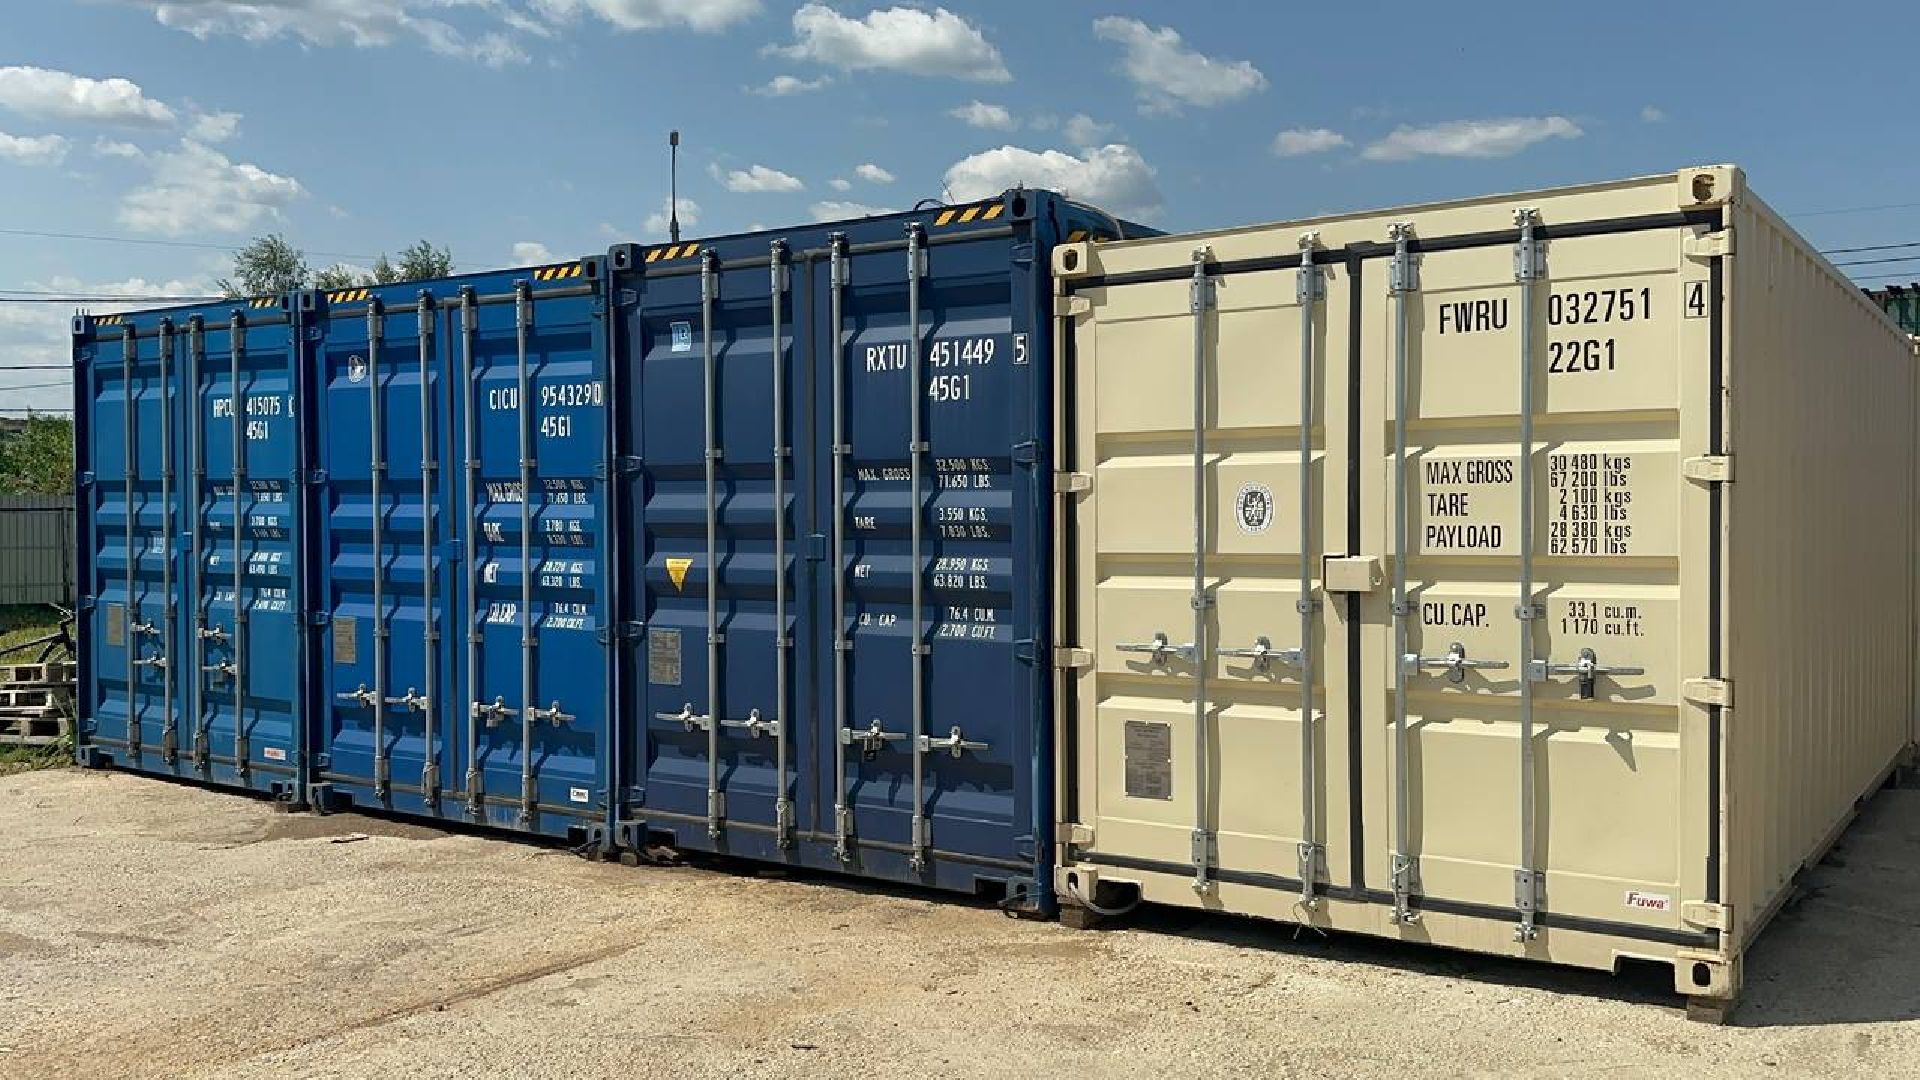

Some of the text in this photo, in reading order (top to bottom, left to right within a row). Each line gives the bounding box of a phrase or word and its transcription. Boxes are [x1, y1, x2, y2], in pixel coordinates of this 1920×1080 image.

[1439, 282, 1706, 334] FWRU 032751 4
[866, 335, 1027, 372] RXTU 451449 5
[1548, 338, 1615, 374] 22G1
[928, 374, 970, 401] 45G1
[246, 395, 280, 416] 415075
[489, 387, 518, 410] CICU
[1426, 459, 1513, 484] MAX GROSS
[1550, 453, 1632, 474] 30 480 kgs
[882, 467, 911, 481] GROSS
[938, 475, 992, 488] 71.650 LBS.
[1550, 471, 1627, 487] 67 200 lbs
[1427, 492, 1469, 517] TARE
[1559, 488, 1632, 508] 2 100 kgs
[939, 507, 964, 521] 3.550
[1559, 504, 1627, 521] 4 630 lbs
[1426, 525, 1502, 548] PAYLOAD
[1550, 521, 1632, 541] 28 380 kgs
[1550, 538, 1627, 554] 62 570 lbs
[854, 564, 872, 578] NET
[933, 574, 964, 587] 63.820
[949, 606, 968, 620] 76.4
[1568, 601, 1642, 619] 33.1 cu.m.
[1604, 620, 1645, 637] cu.ft.
[1626, 892, 1664, 909] Fuwa
